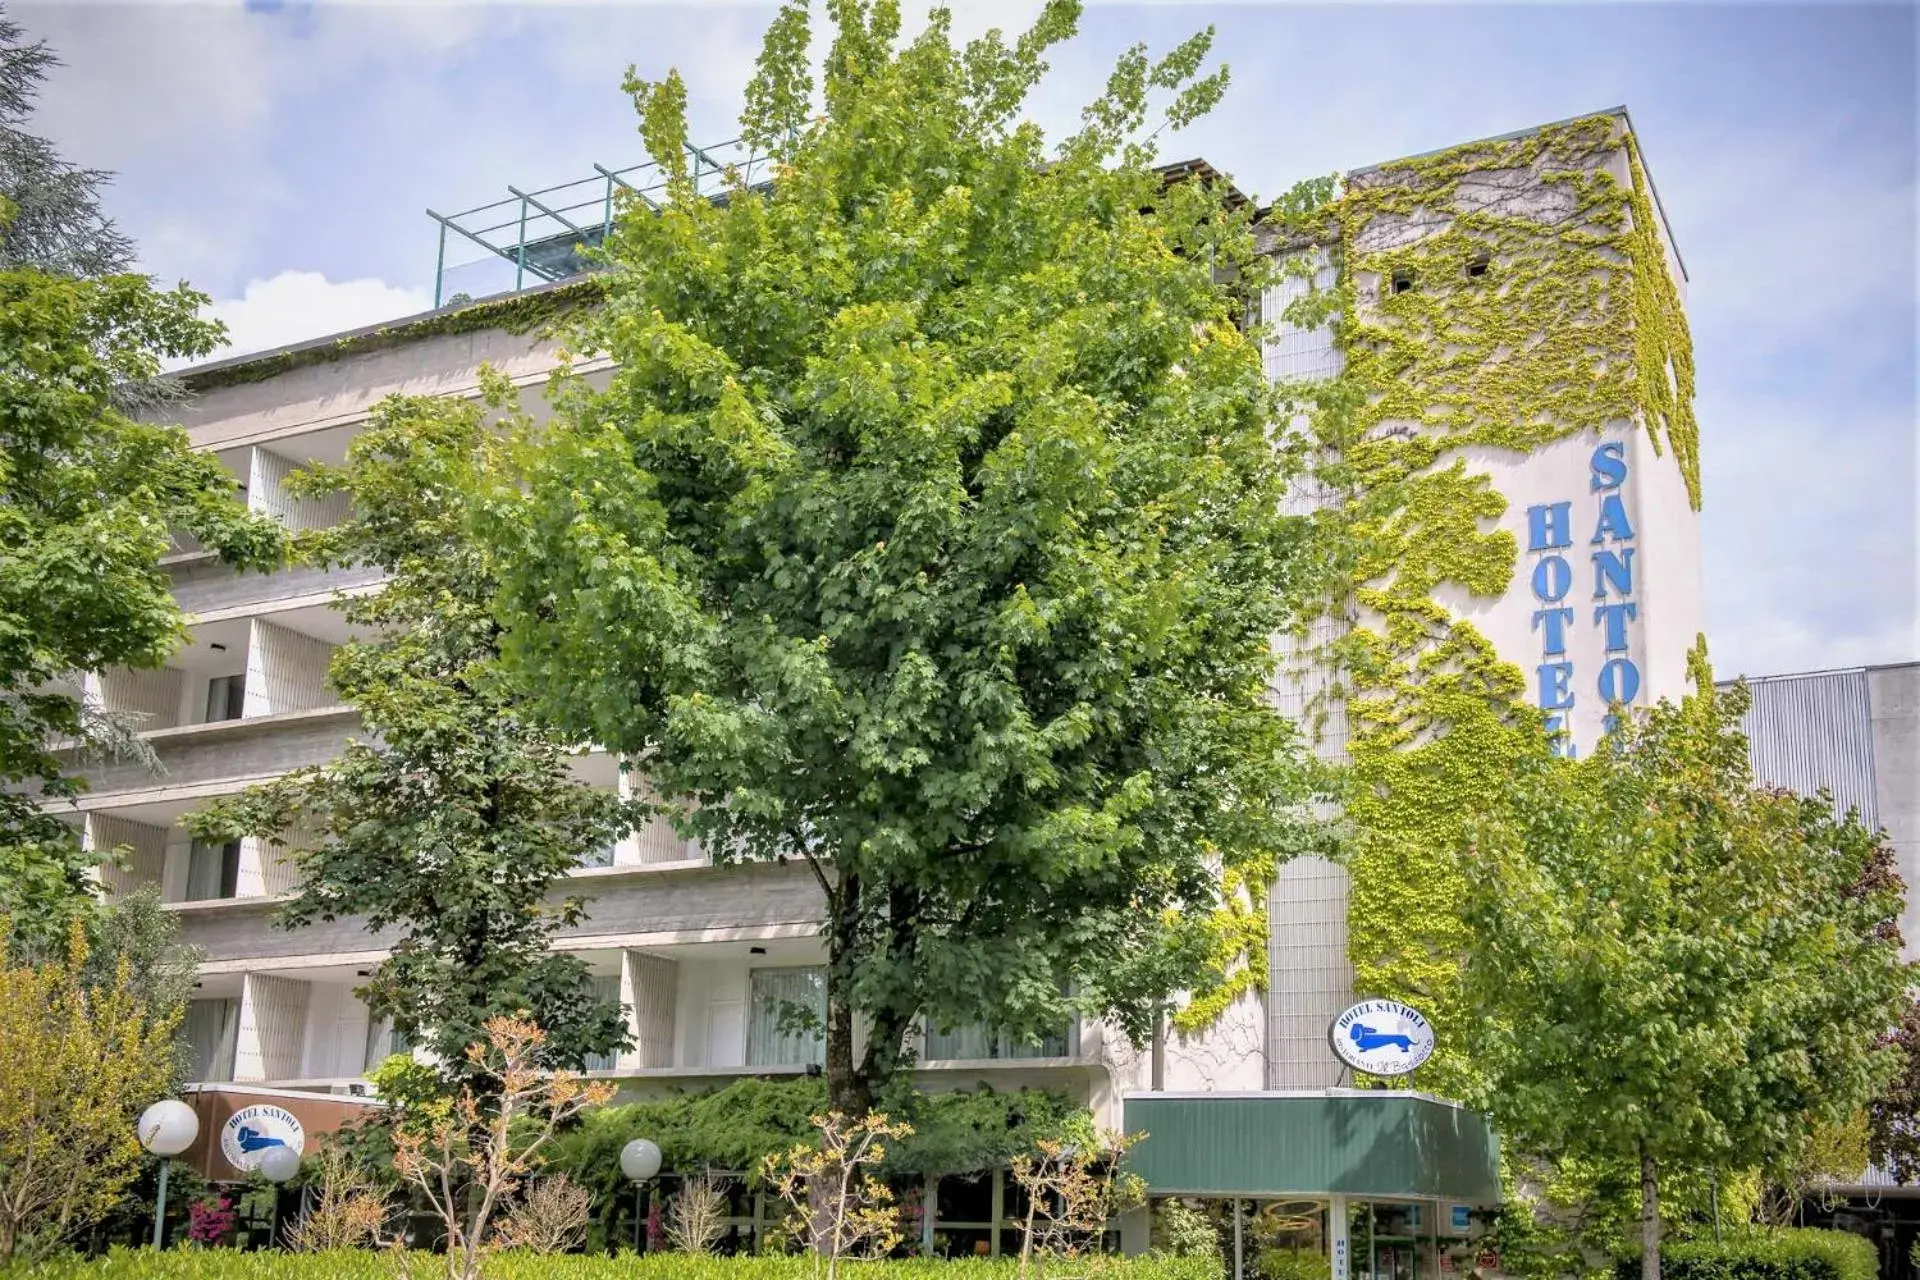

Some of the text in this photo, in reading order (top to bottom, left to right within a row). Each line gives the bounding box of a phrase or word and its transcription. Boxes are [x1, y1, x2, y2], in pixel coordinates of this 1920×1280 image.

[1339, 1003, 1425, 1029] HOTEL SANTOLI
[229, 1107, 259, 1129] HOTEL
